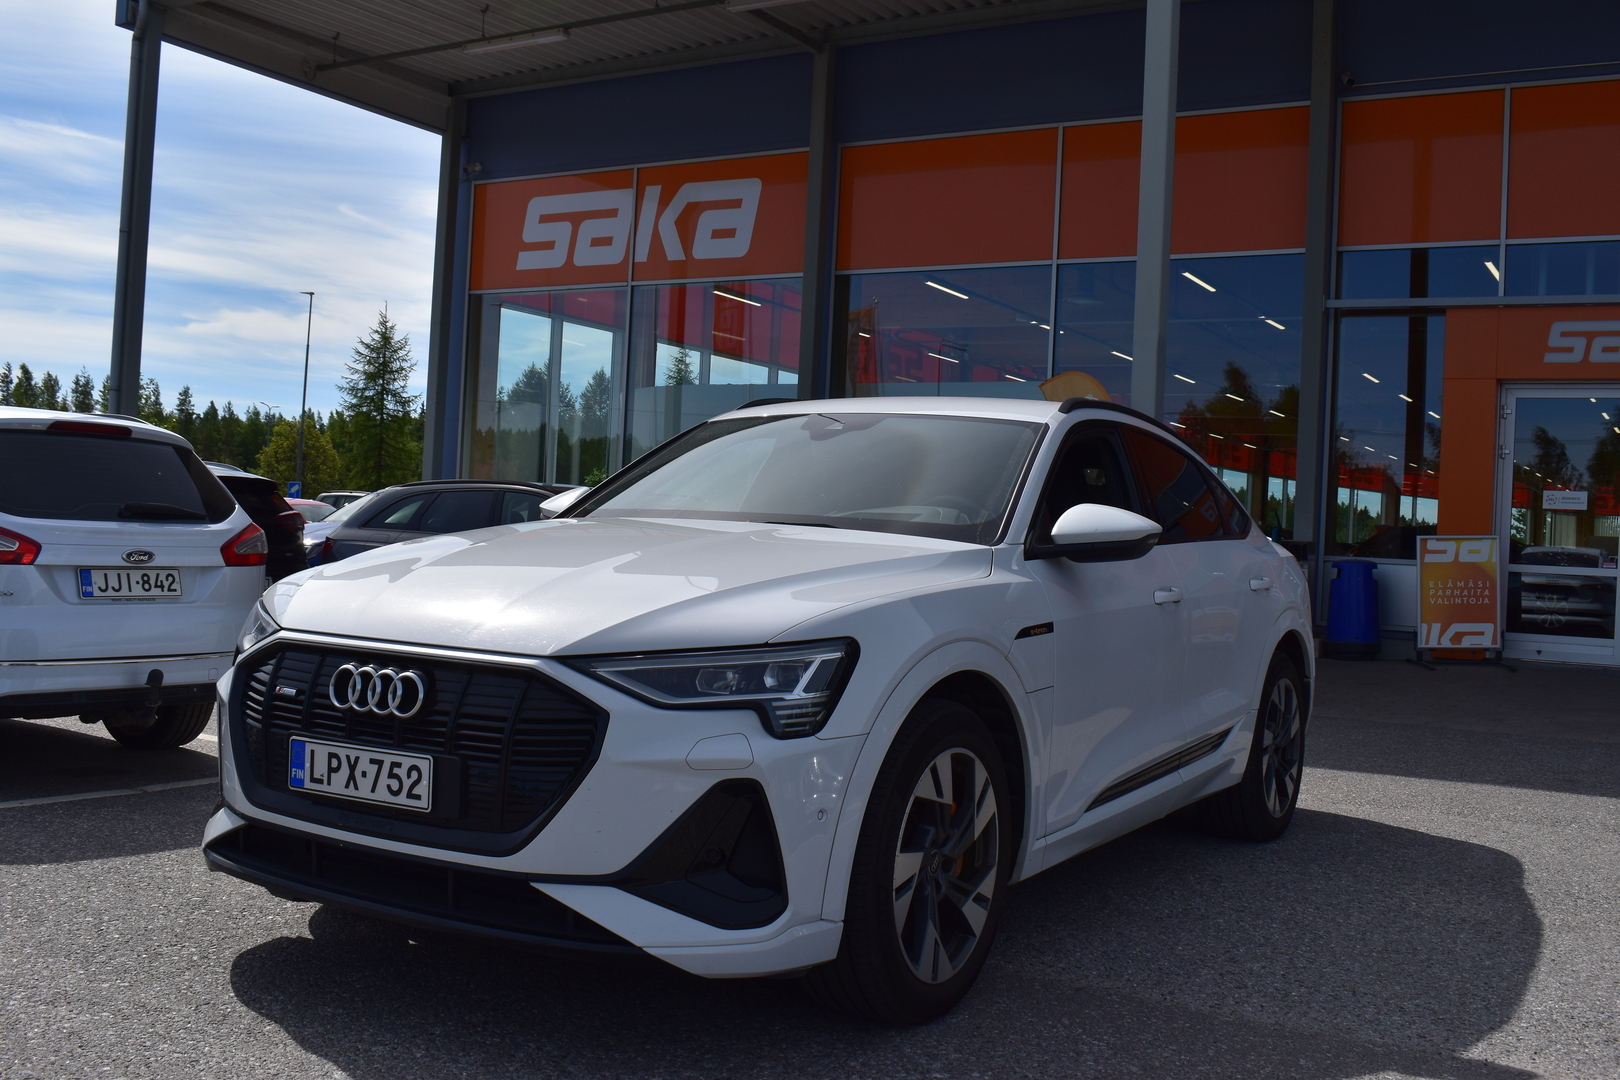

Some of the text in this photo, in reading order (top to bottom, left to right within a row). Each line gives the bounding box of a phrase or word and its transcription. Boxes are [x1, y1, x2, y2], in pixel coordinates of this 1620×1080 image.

[130, 552, 149, 561] Ford
[82, 572, 177, 593] FIN JJI-842
[1429, 579, 1490, 588] ELÄMÄSI
[291, 749, 423, 801] FIN LPX-752
